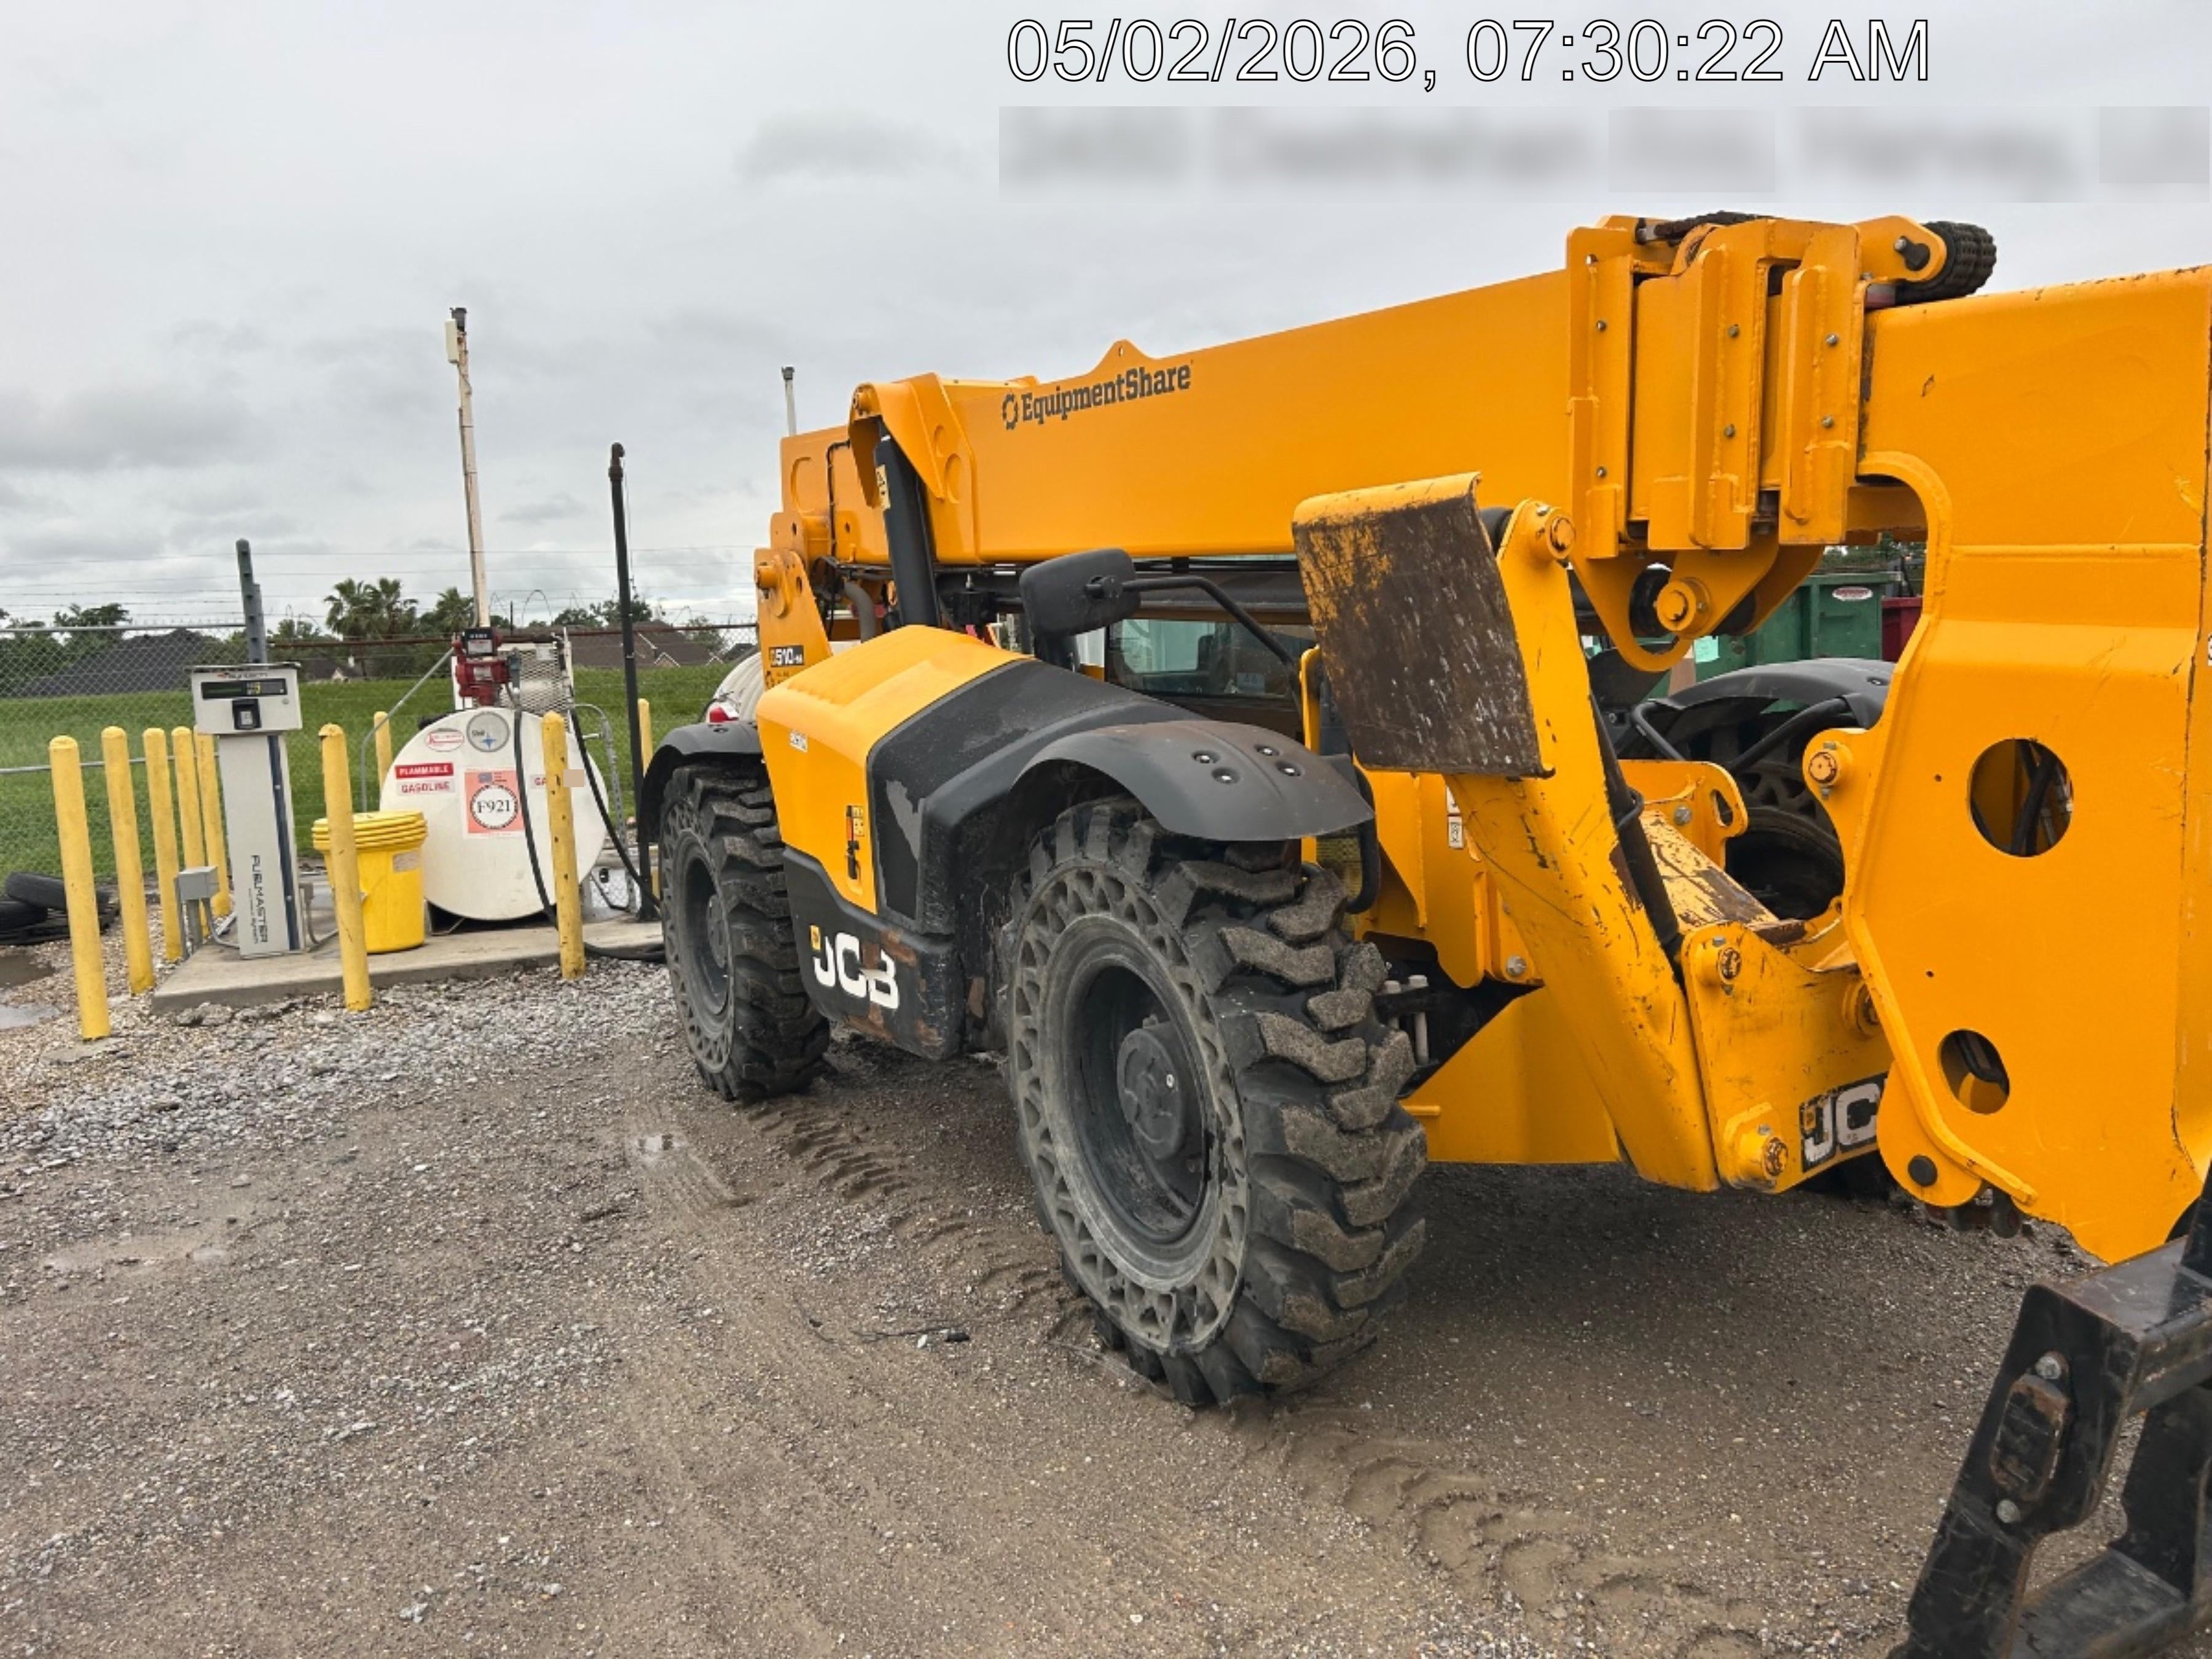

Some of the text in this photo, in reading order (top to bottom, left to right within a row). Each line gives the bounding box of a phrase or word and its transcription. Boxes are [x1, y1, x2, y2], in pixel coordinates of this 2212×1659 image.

[1021, 364, 1191, 424] EquipmentShare
[402, 782, 450, 793] GASOLINE
[477, 800, 510, 814] F921
[812, 931, 900, 1009] JCB
[1803, 1081, 1888, 1163] JC
